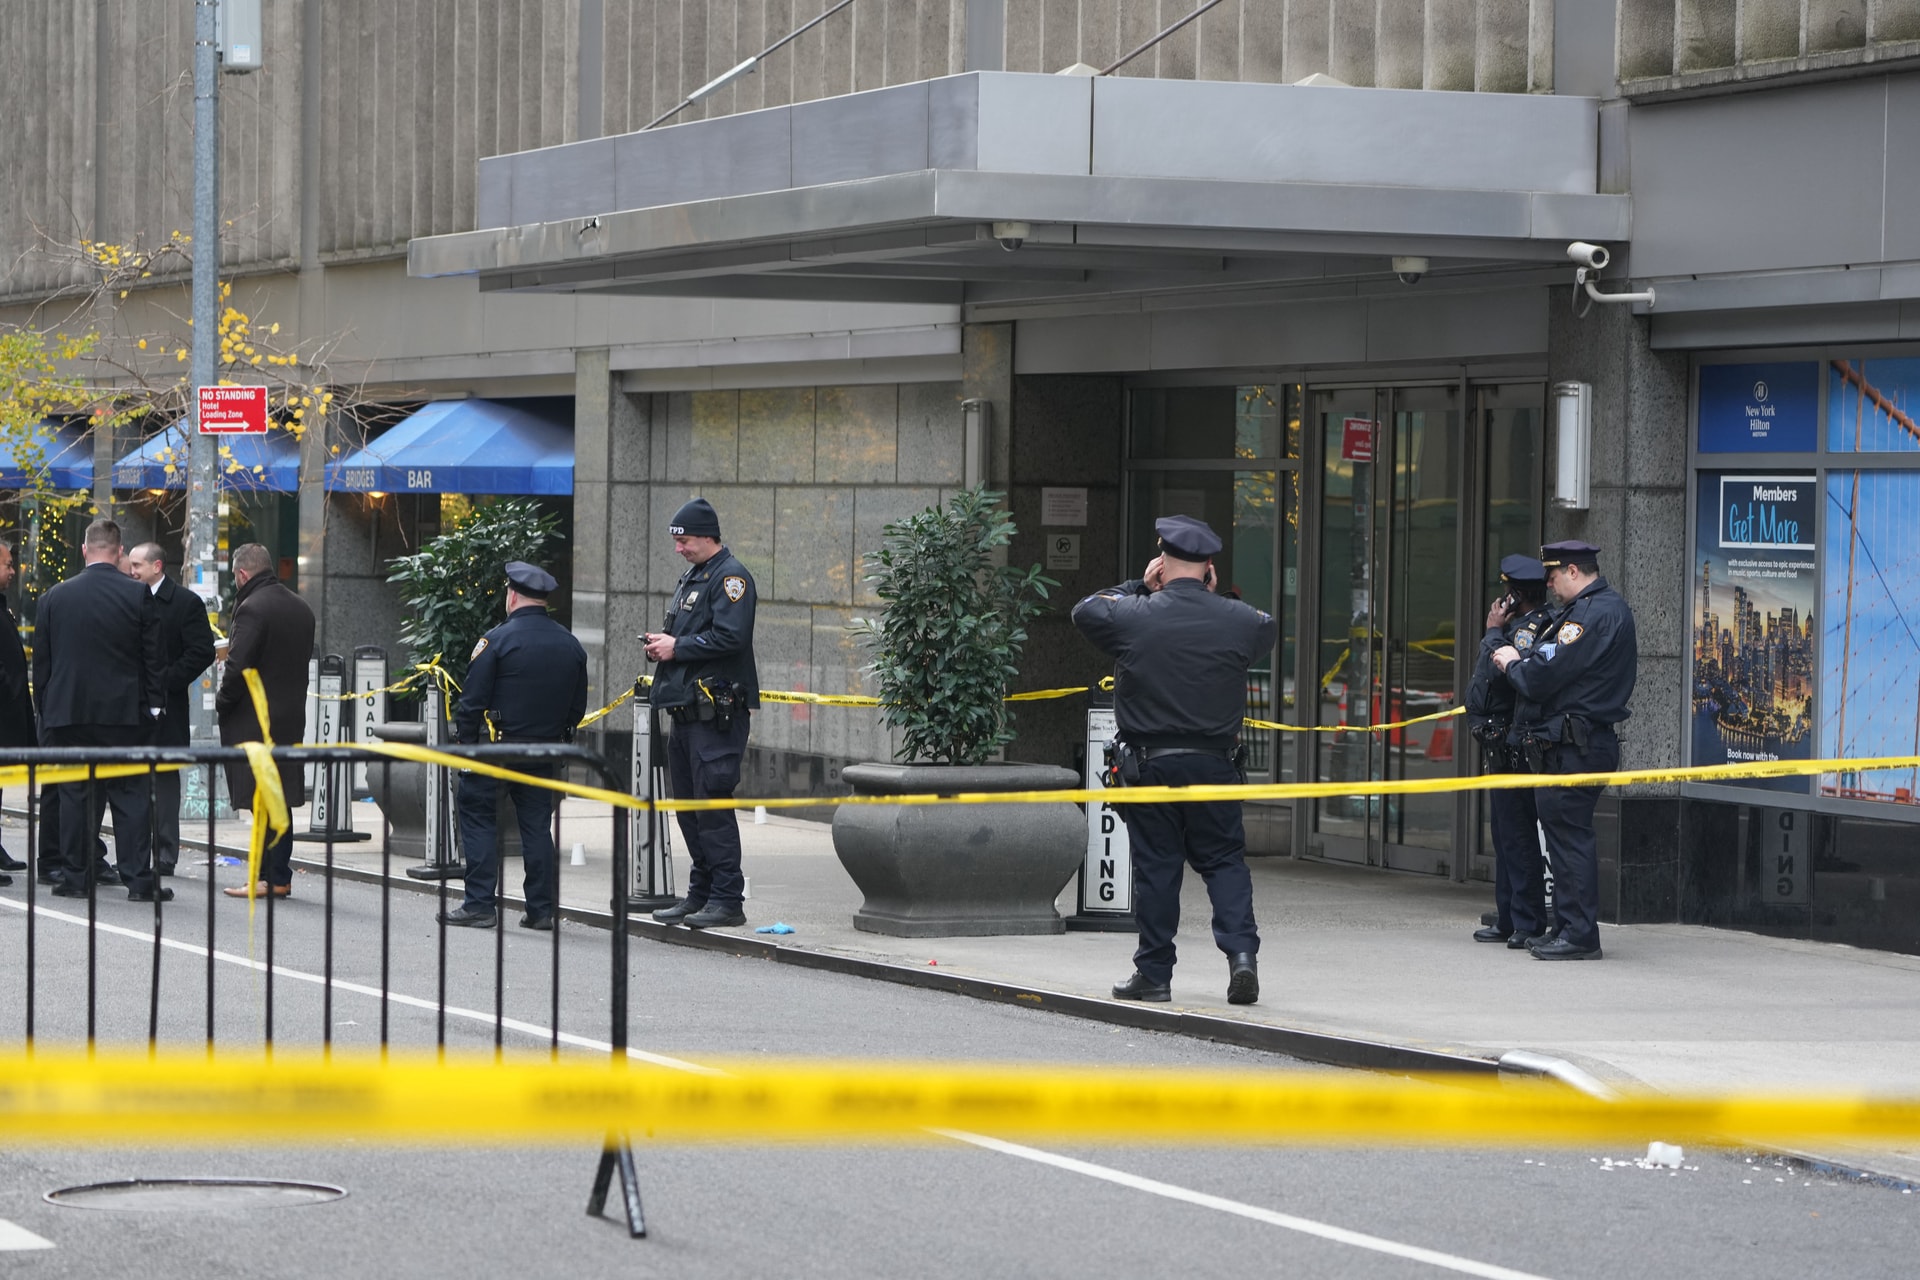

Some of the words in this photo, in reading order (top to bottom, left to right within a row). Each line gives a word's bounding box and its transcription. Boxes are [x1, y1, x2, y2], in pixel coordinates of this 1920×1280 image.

[202, 391, 214, 400] NO
[215, 390, 256, 400] STANDING
[202, 402, 219, 410] Hotel
[1745, 405, 1760, 417] New
[1760, 404, 1776, 417] York
[202, 410, 226, 420] Loading
[228, 410, 243, 418] Zone
[1750, 418, 1770, 431] Hilton
[345, 469, 375, 488] BRIDGES
[407, 469, 432, 489] BAR
[1753, 485, 1797, 502] Members
[1729, 501, 1755, 545] Get
[1760, 503, 1799, 545] More
[1728, 559, 1738, 567] with
[1738, 559, 1758, 568] exclusive
[1773, 560, 1778, 568] to
[1779, 561, 1788, 570] epic
[1788, 561, 1815, 570] experiences
[1728, 568, 1733, 576] in
[1762, 570, 1777, 578] culture
[1778, 570, 1786, 578] and
[1786, 570, 1798, 578] food
[1727, 748, 1741, 758] Book
[1743, 751, 1755, 760] now
[1755, 751, 1768, 761] with
[1769, 753, 1779, 762] the
